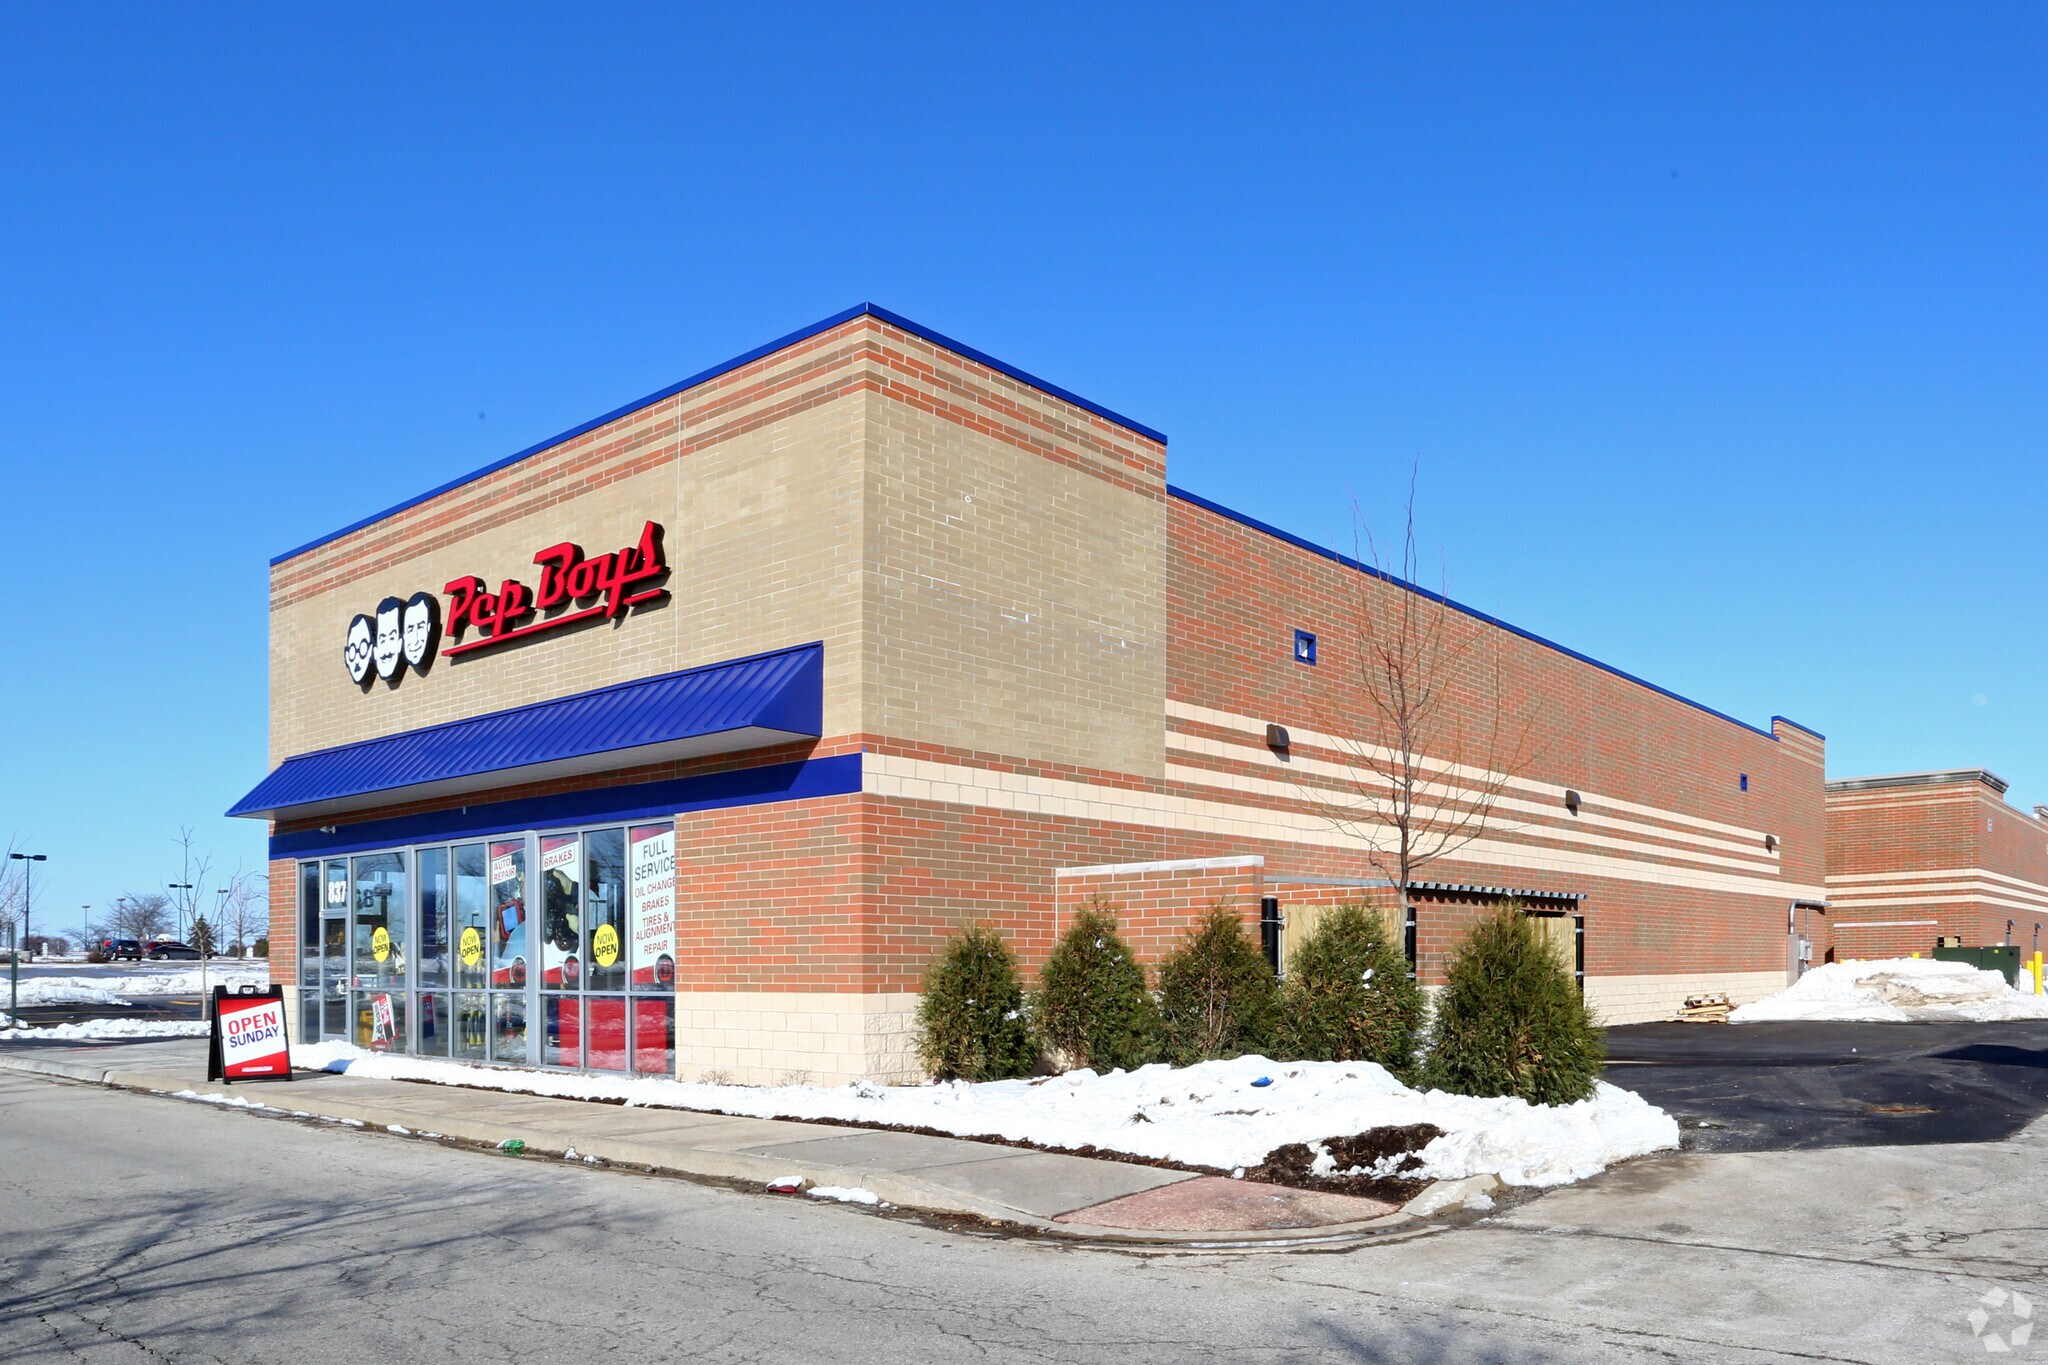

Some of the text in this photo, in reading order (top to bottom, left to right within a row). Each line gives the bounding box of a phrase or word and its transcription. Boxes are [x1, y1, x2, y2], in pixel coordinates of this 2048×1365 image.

[443, 520, 666, 638] Pep Boys
[643, 839, 668, 859] FULL
[493, 857, 511, 871] AUTO
[544, 849, 573, 868] BRAKES
[493, 867, 515, 882] REPAIR
[634, 855, 676, 881] SERVICE
[328, 881, 346, 903] 837
[634, 877, 676, 898] OIL CHANGE
[642, 895, 670, 913] BRAKES
[642, 911, 669, 929] TIRES &
[374, 934, 387, 944] NOW
[596, 931, 615, 946] NOW
[635, 921, 676, 941] ALIGNMENT
[373, 943, 388, 955] OPEN
[462, 934, 477, 947] NOW
[643, 940, 668, 956] REPAIR
[461, 944, 480, 958] OPEN
[595, 944, 617, 958] OPEN
[228, 1010, 277, 1035] OPEN
[229, 1025, 279, 1048] SUNDAY
